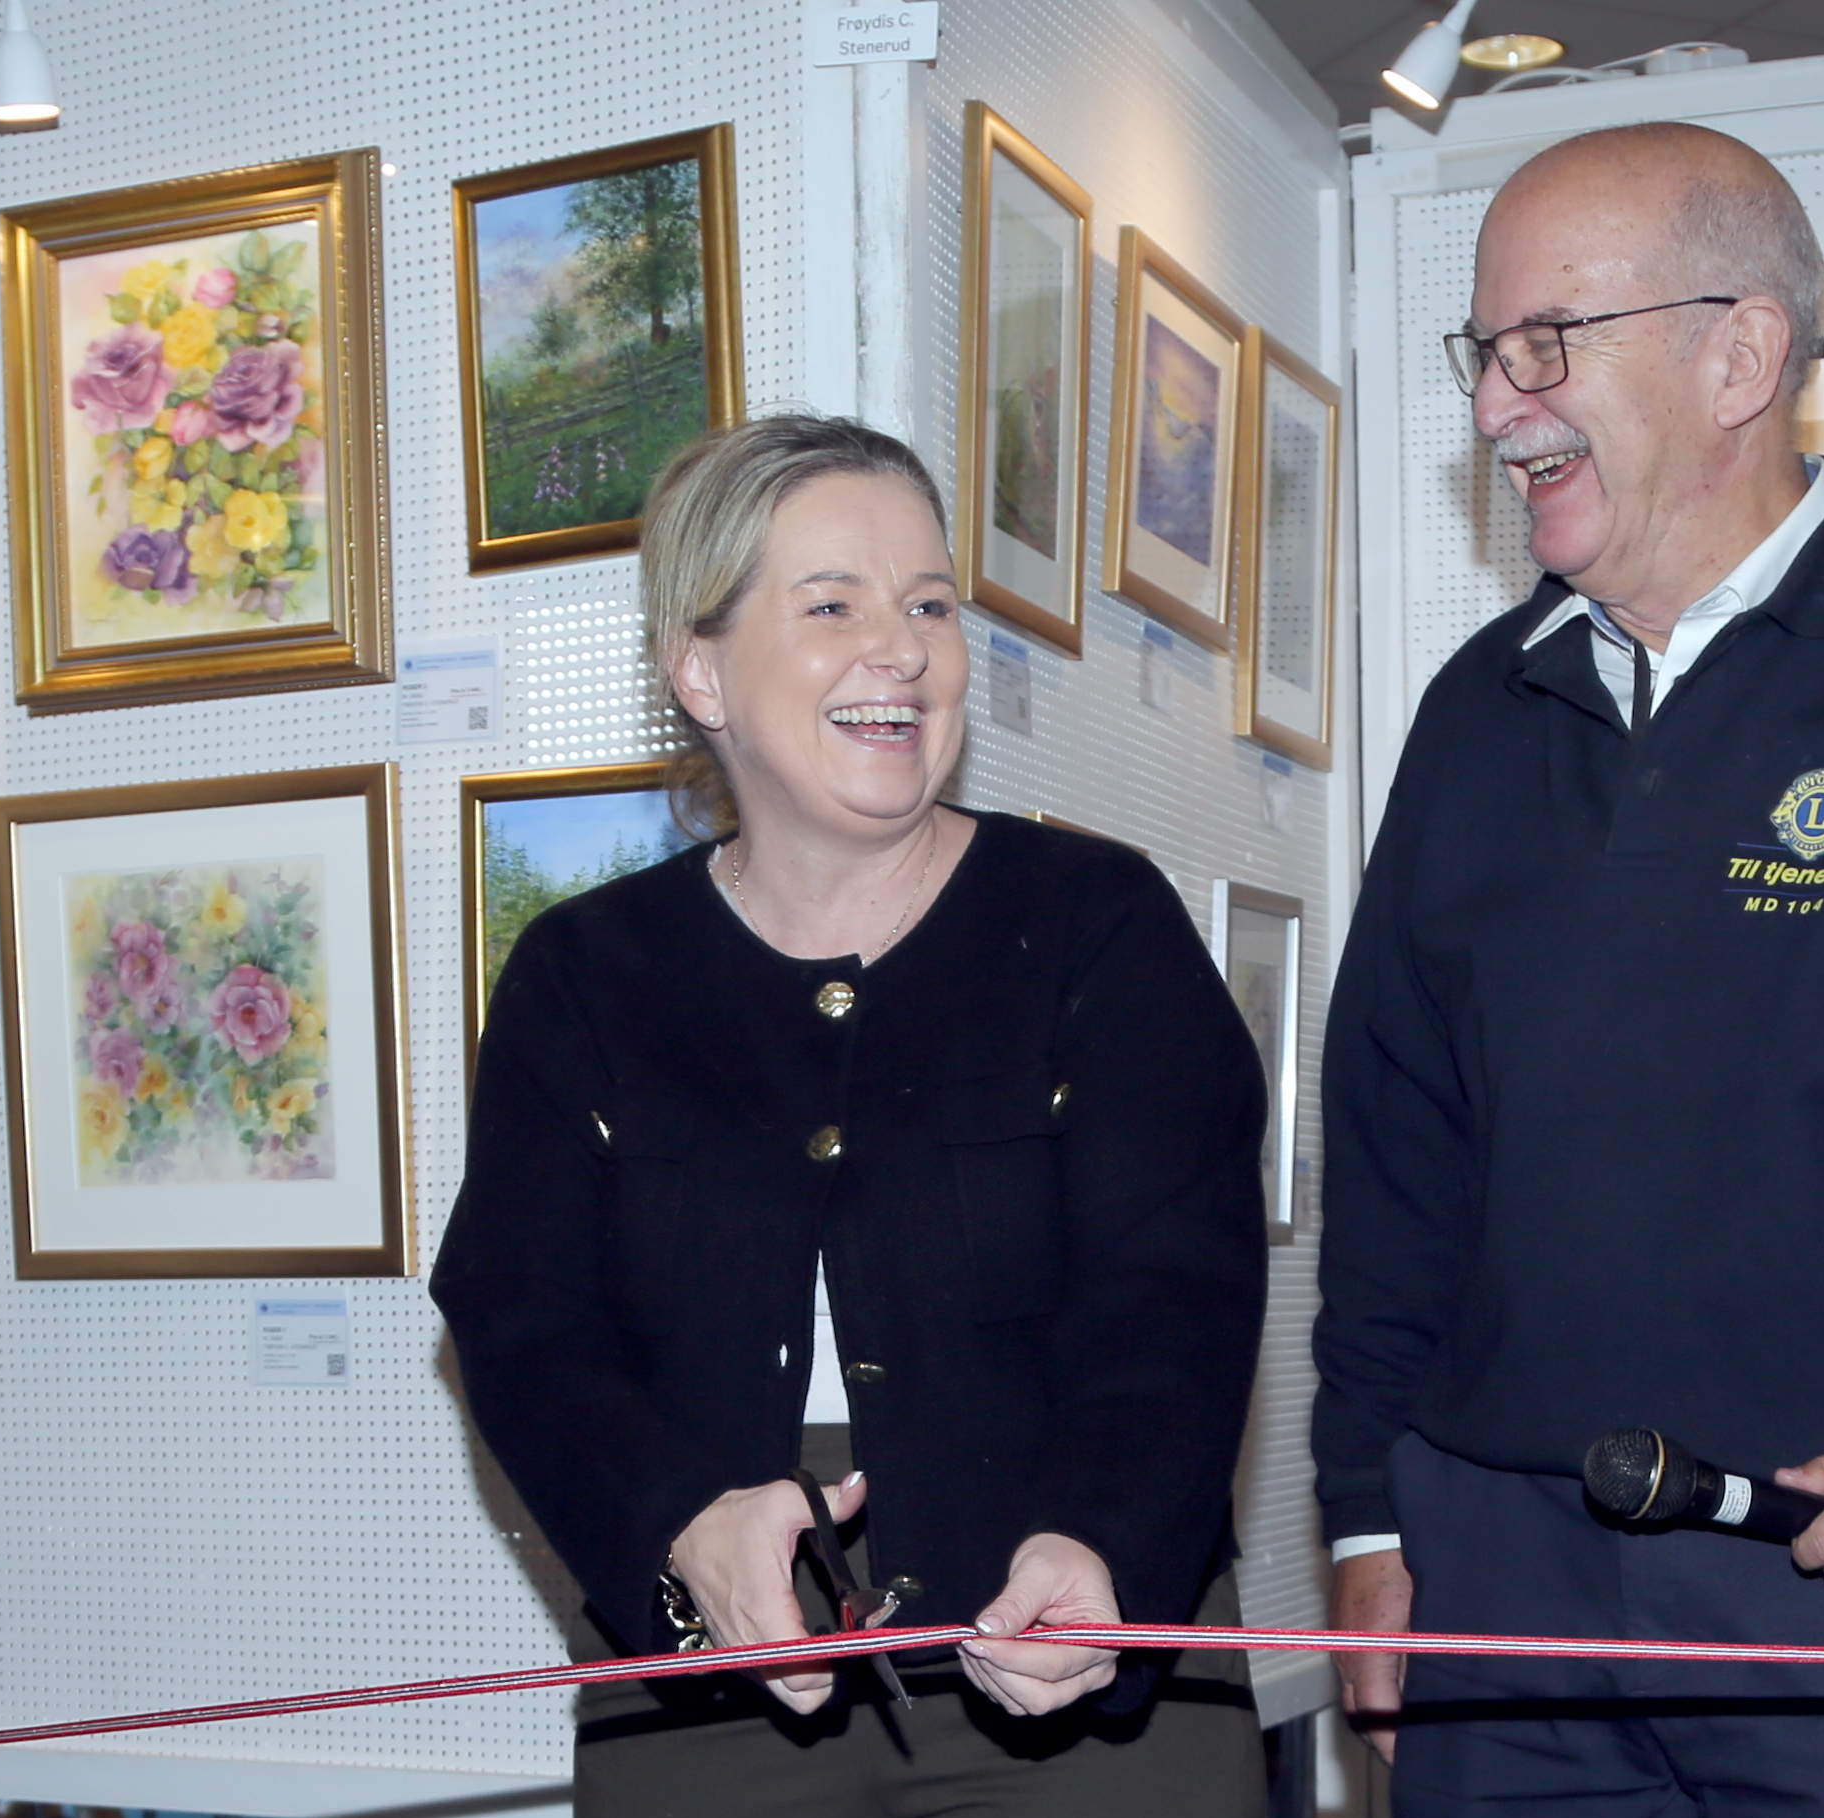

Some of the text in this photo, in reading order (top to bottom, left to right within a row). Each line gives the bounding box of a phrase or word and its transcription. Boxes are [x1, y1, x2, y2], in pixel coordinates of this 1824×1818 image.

[838, 12, 914, 33] Frøydis C.
[839, 37, 911, 56] Stenerud
[1727, 857, 1761, 879] Til
